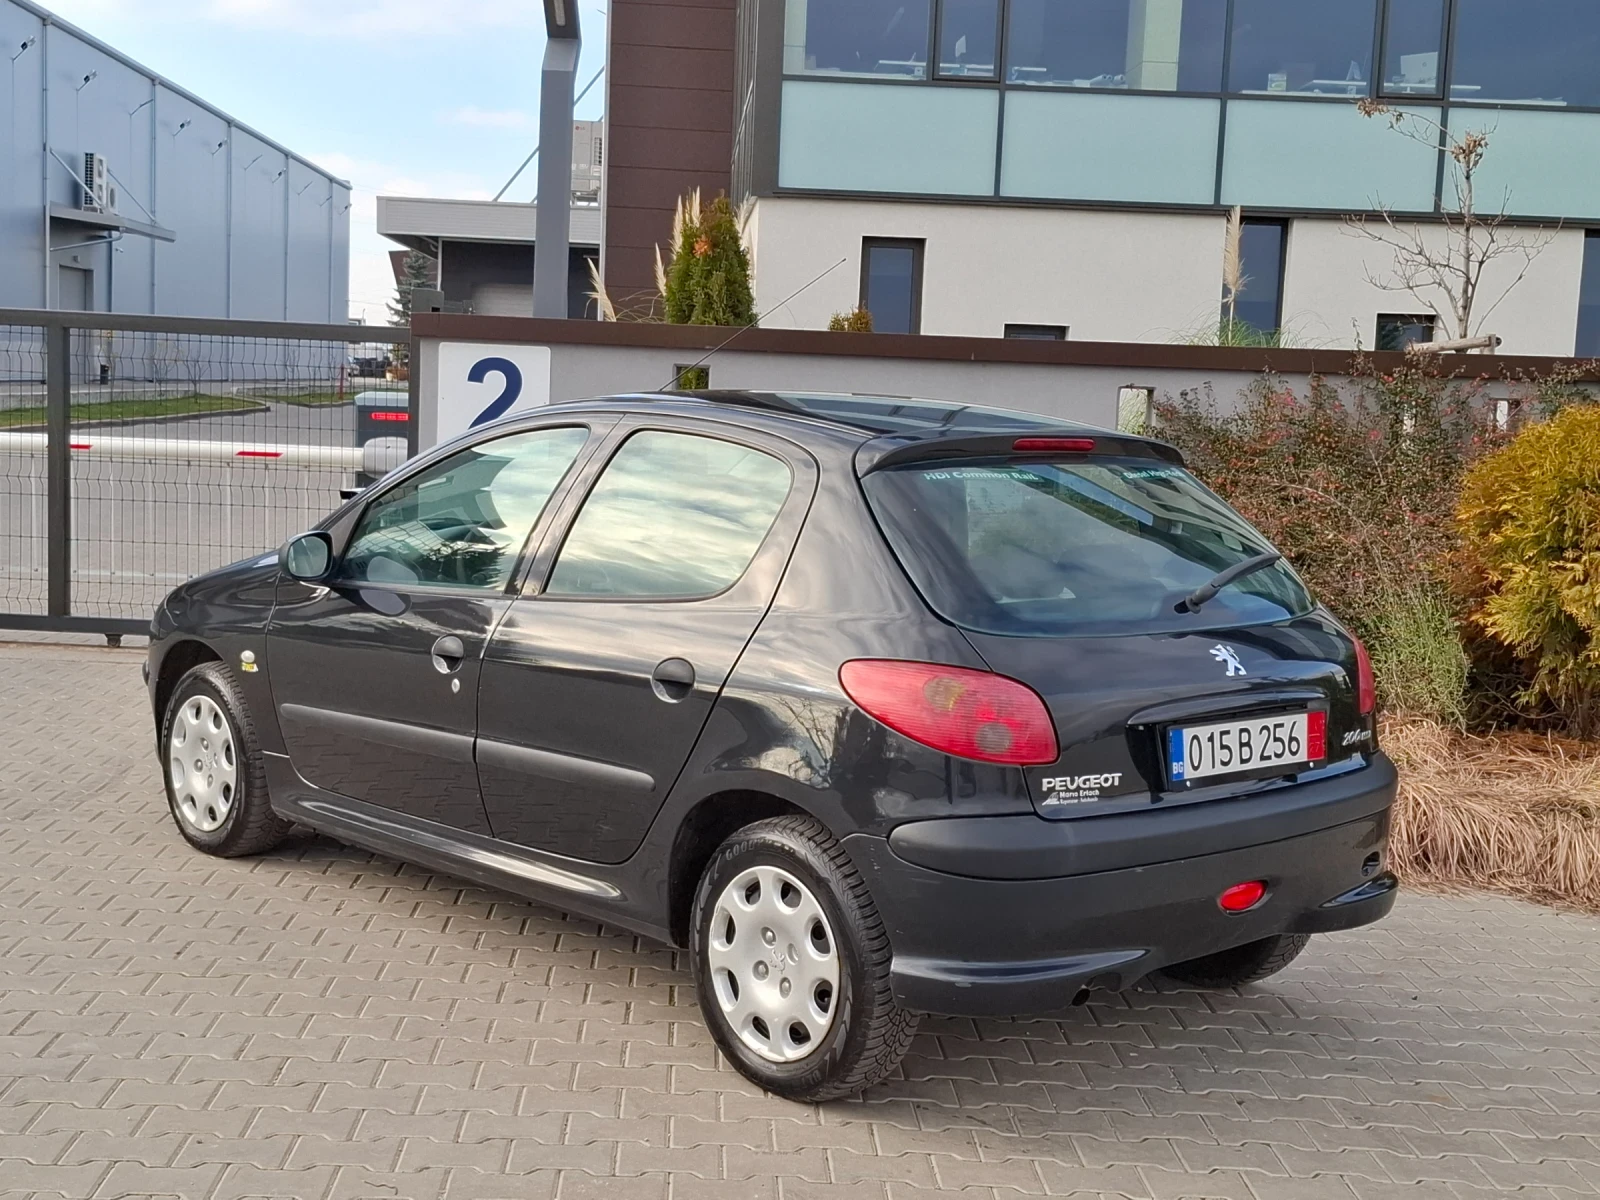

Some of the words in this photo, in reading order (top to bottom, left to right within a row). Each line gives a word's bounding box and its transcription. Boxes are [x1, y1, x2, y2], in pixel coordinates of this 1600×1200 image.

[467, 357, 523, 430] 2
[952, 471, 1011, 479] Common
[1172, 761, 1184, 774] BG
[1041, 772, 1123, 791] PEUGEOT
